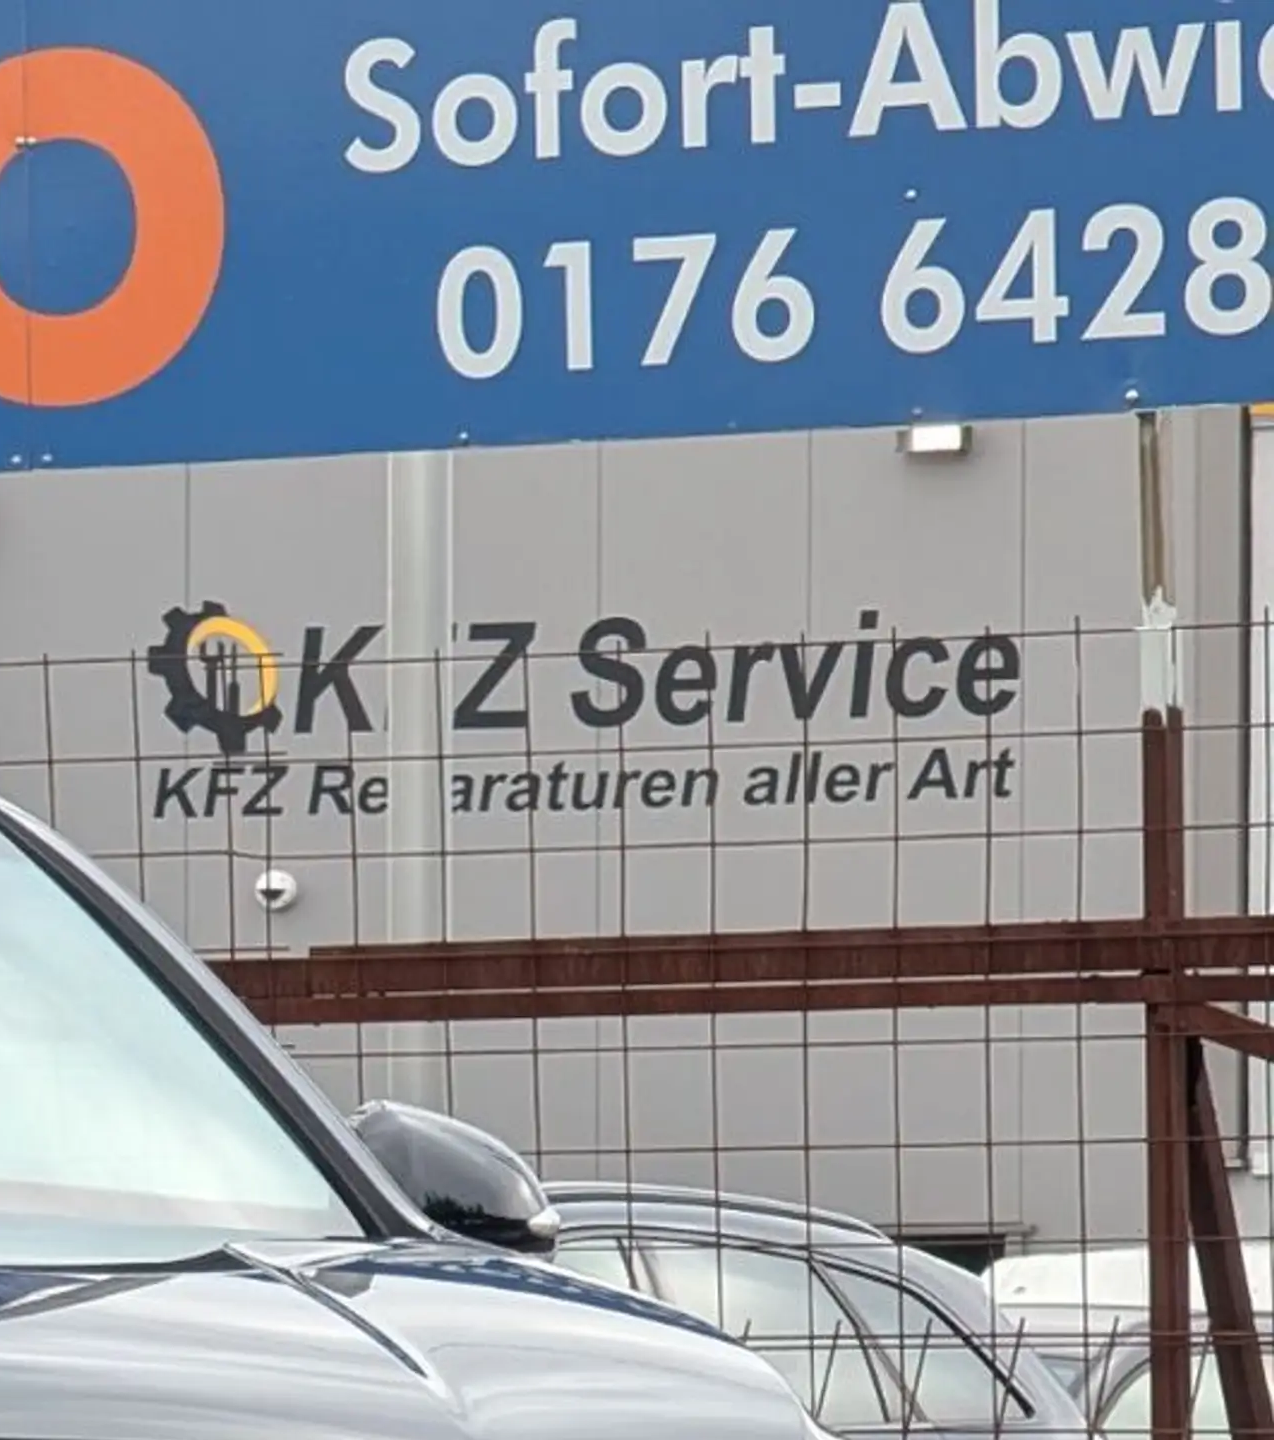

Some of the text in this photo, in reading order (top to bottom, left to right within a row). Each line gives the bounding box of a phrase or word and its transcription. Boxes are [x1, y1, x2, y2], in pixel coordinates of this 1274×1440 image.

[343, 0, 1274, 174] Sofort-Abwi
[435, 196, 1273, 380] 0176 6428
[293, 609, 1022, 734] KZ Service
[152, 747, 1016, 818] KFZ Rearaturen aller Art
